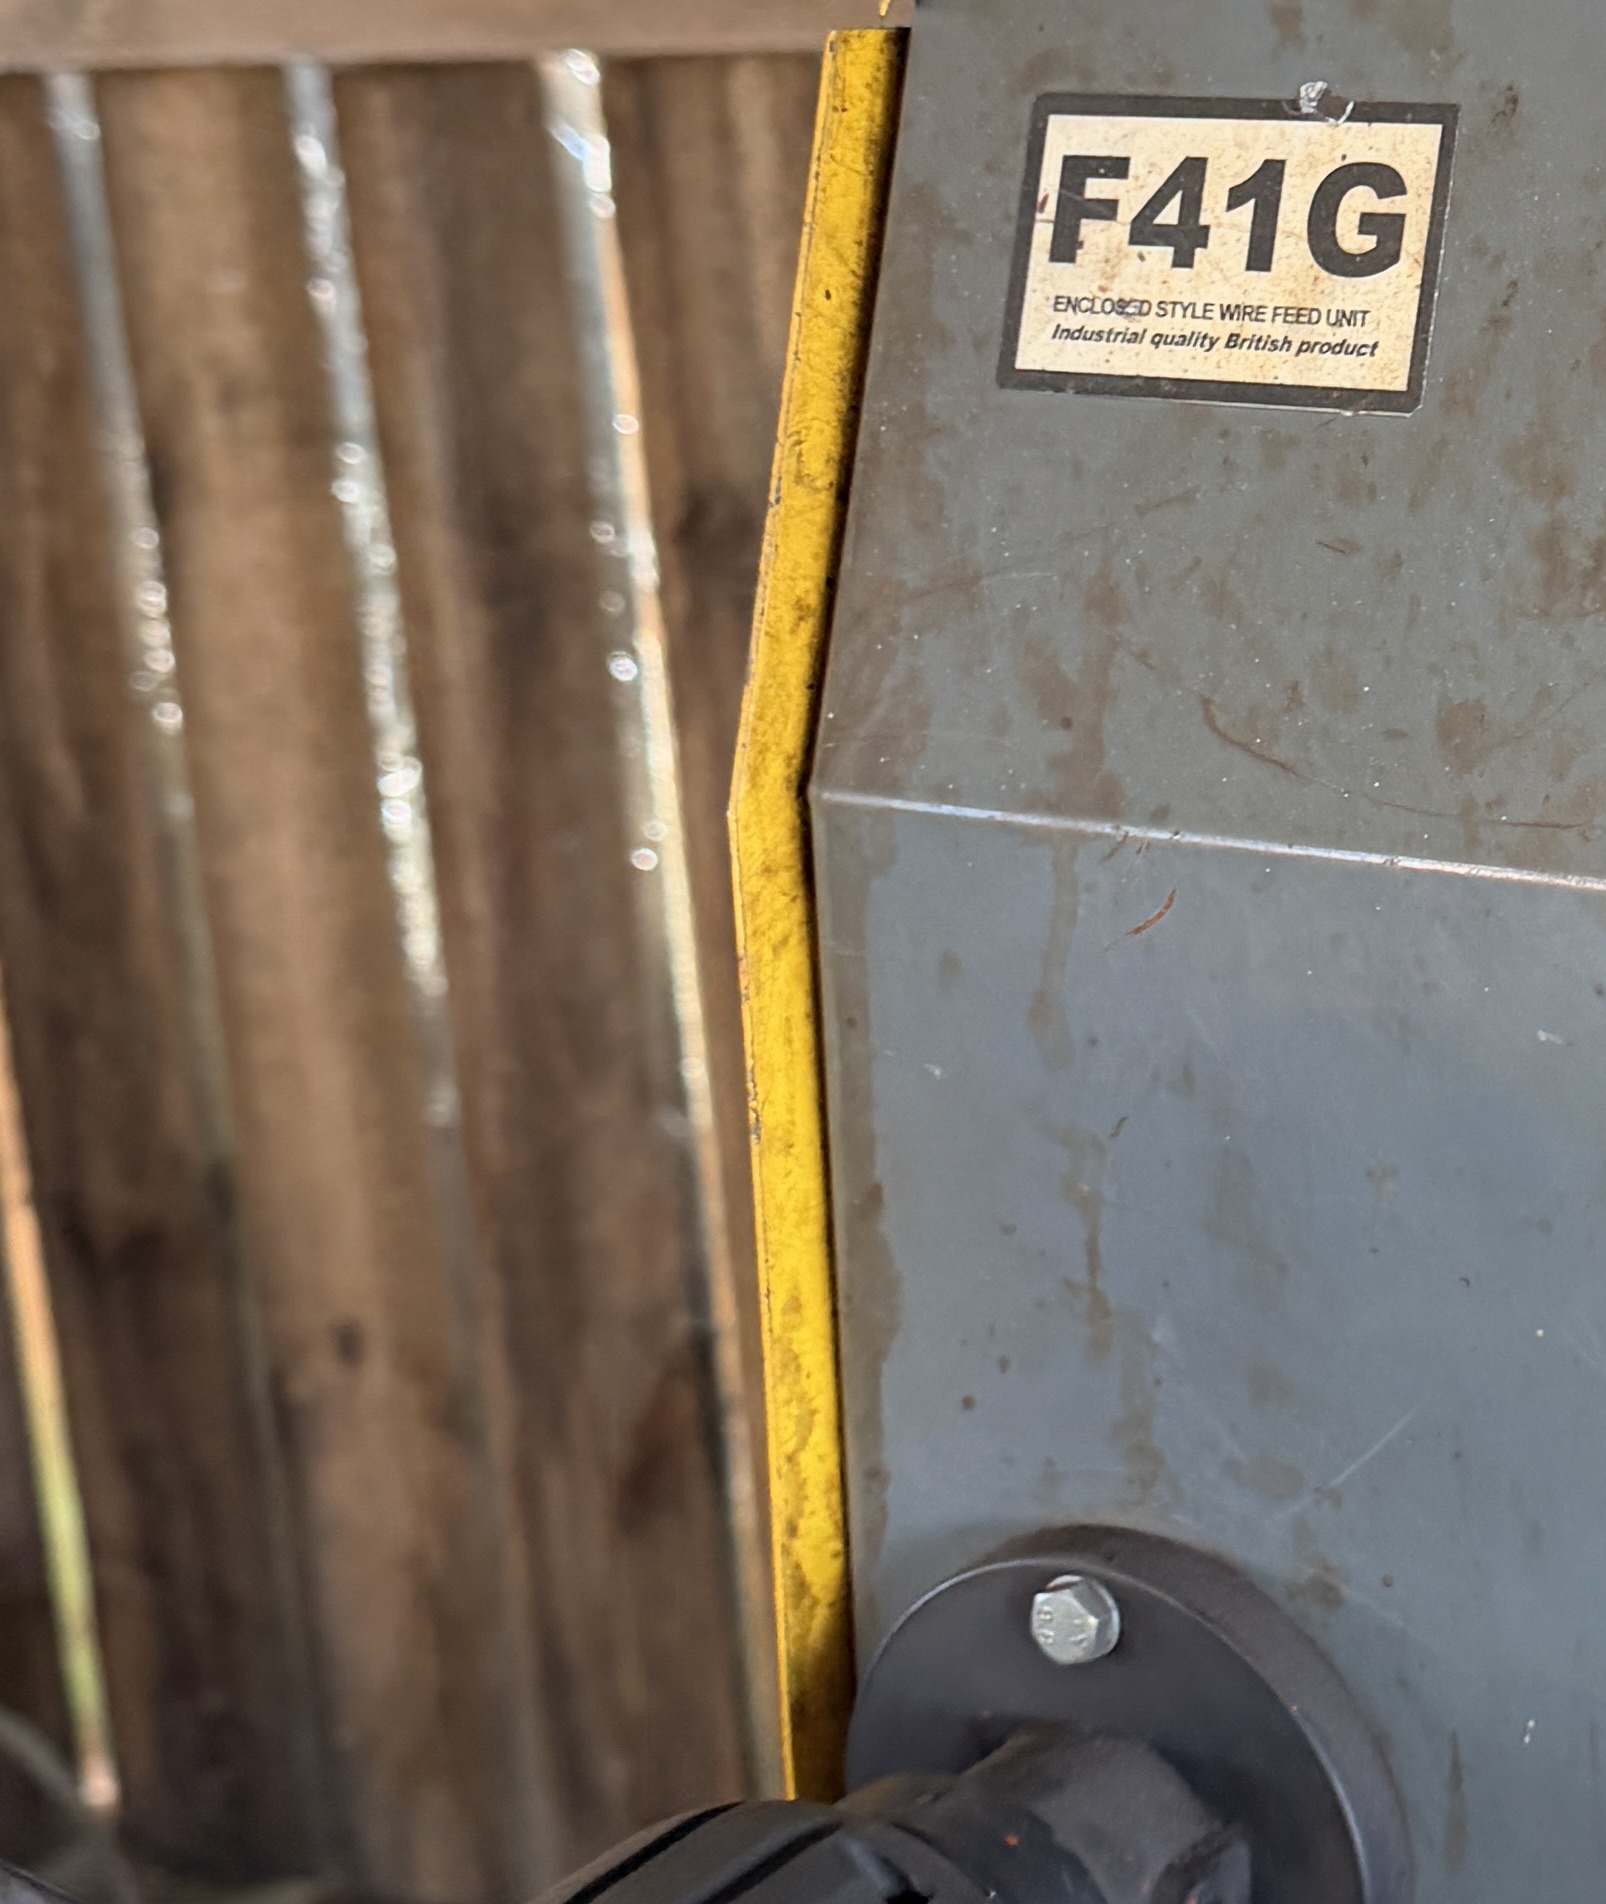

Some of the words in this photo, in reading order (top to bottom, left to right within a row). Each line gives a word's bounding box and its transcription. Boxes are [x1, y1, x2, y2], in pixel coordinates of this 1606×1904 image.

[1048, 153, 1409, 279] F41G
[1155, 300, 1214, 321] STYLE
[1220, 303, 1267, 323] WIRE
[1270, 305, 1322, 326] FEED
[1325, 308, 1371, 328] UNIT
[1051, 323, 1148, 345] Industrial
[1150, 331, 1221, 352] quality
[1223, 334, 1293, 353] British
[1295, 338, 1379, 358] product
